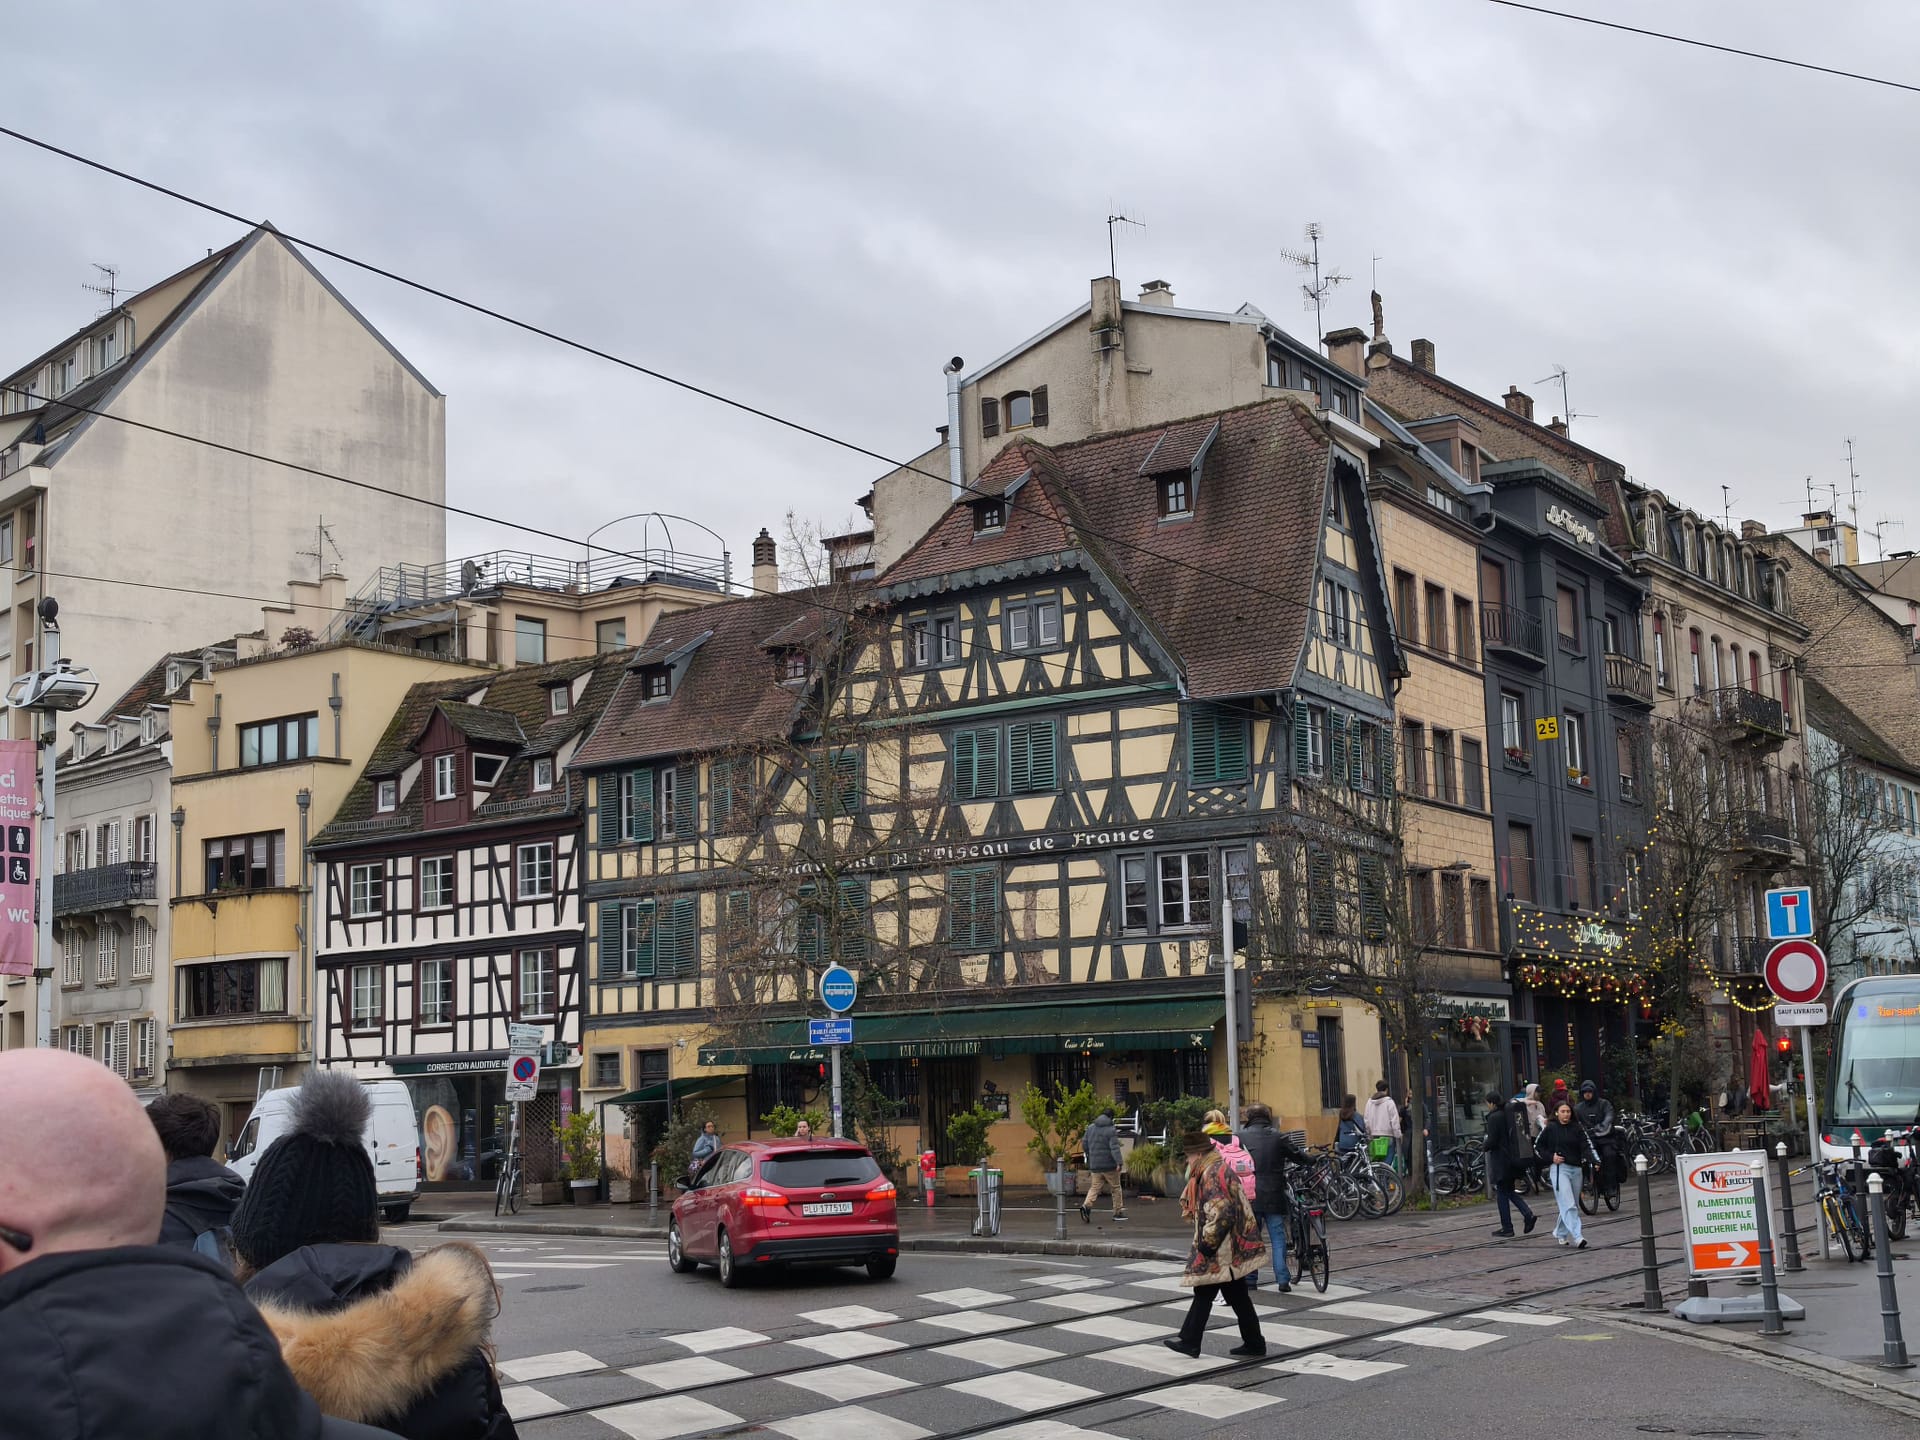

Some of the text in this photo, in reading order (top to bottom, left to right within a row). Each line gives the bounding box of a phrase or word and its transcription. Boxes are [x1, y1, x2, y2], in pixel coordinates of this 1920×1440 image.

[1538, 722, 1556, 735] 25
[0, 794, 28, 806] ettes
[1029, 837, 1054, 851] de
[1071, 828, 1155, 848] France
[7, 907, 30, 923] WC
[427, 1061, 469, 1072] CORRECTION
[469, 1060, 500, 1070] AUDITIVE
[1706, 1210, 1752, 1221] ORIENTALE
[1692, 1224, 1738, 1235] BOUCHERIE
